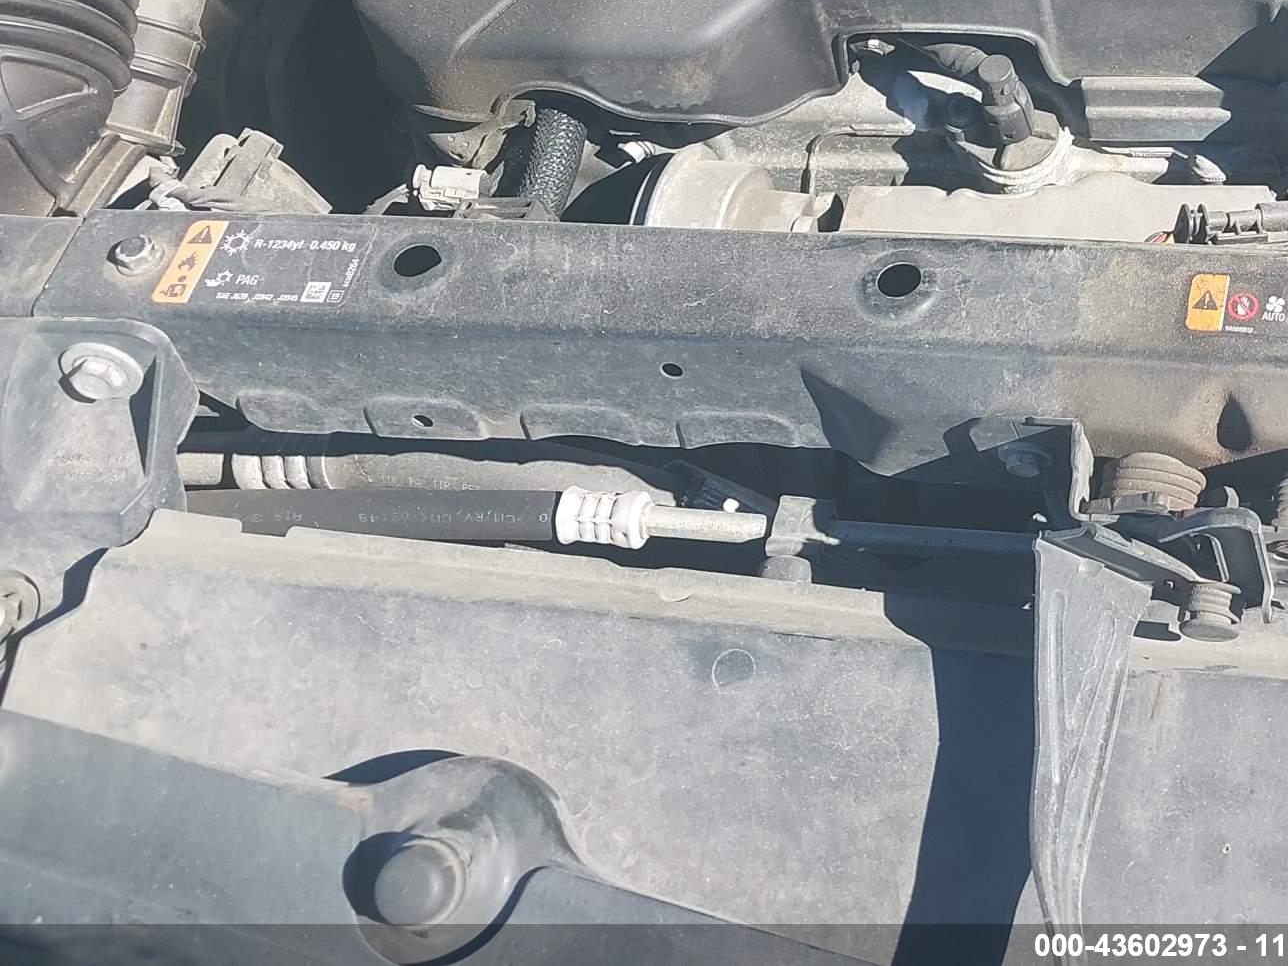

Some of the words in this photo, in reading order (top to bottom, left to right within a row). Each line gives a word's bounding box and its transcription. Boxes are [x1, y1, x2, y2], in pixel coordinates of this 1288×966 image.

[254, 239, 304, 252] R-1234yf
[309, 240, 341, 251] 0.450
[341, 240, 357, 253] kg
[235, 274, 259, 285] PAG
[1262, 312, 1286, 322] AUTO
